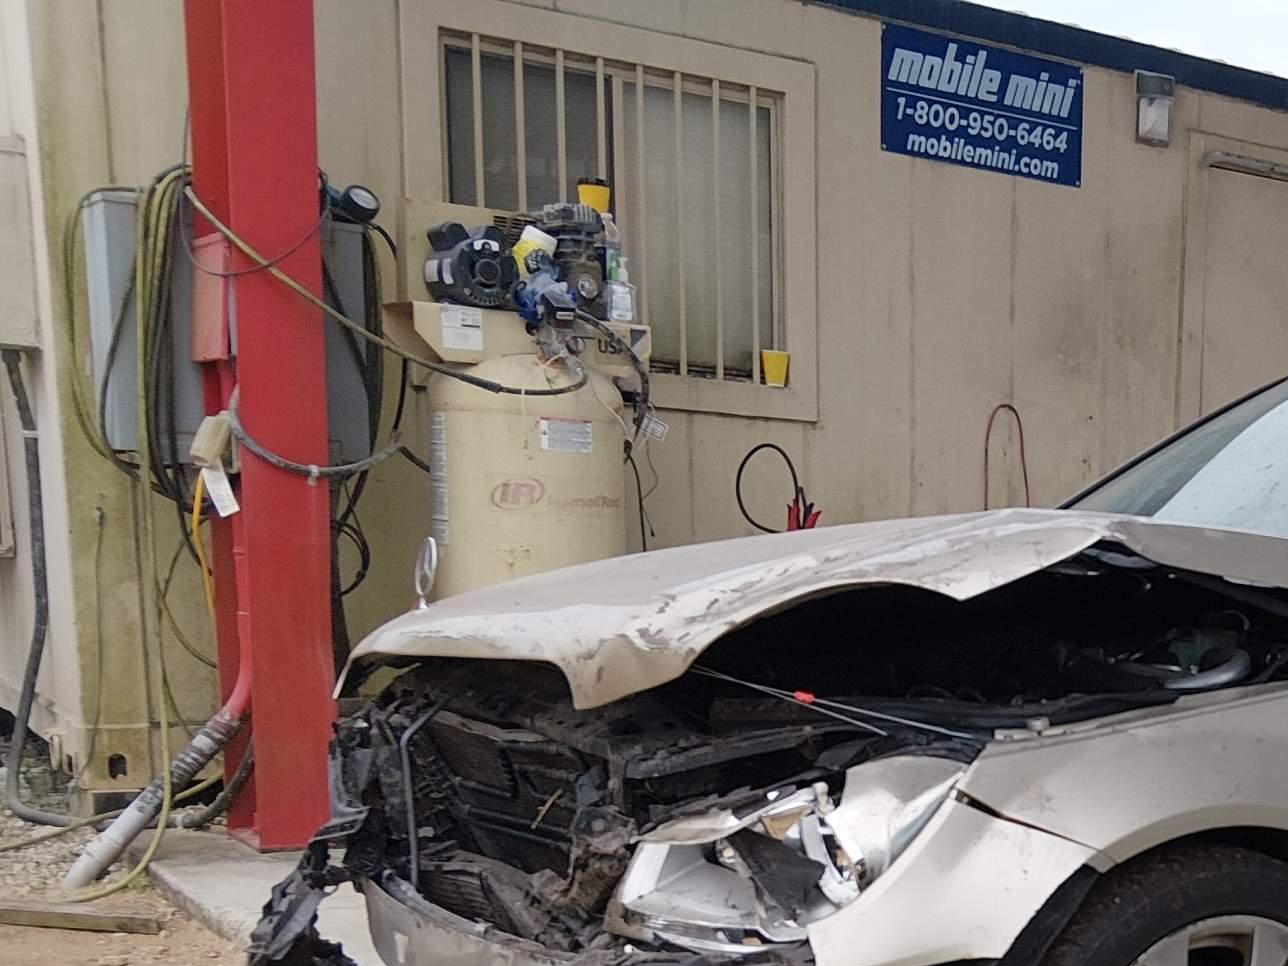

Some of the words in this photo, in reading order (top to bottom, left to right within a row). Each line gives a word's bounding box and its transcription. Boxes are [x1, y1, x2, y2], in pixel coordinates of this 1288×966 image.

[887, 42, 1001, 102] mobile
[1003, 71, 1077, 118] mini
[897, 97, 1068, 153] 1-800-950-6464
[906, 133, 1059, 179] mobilemini.com
